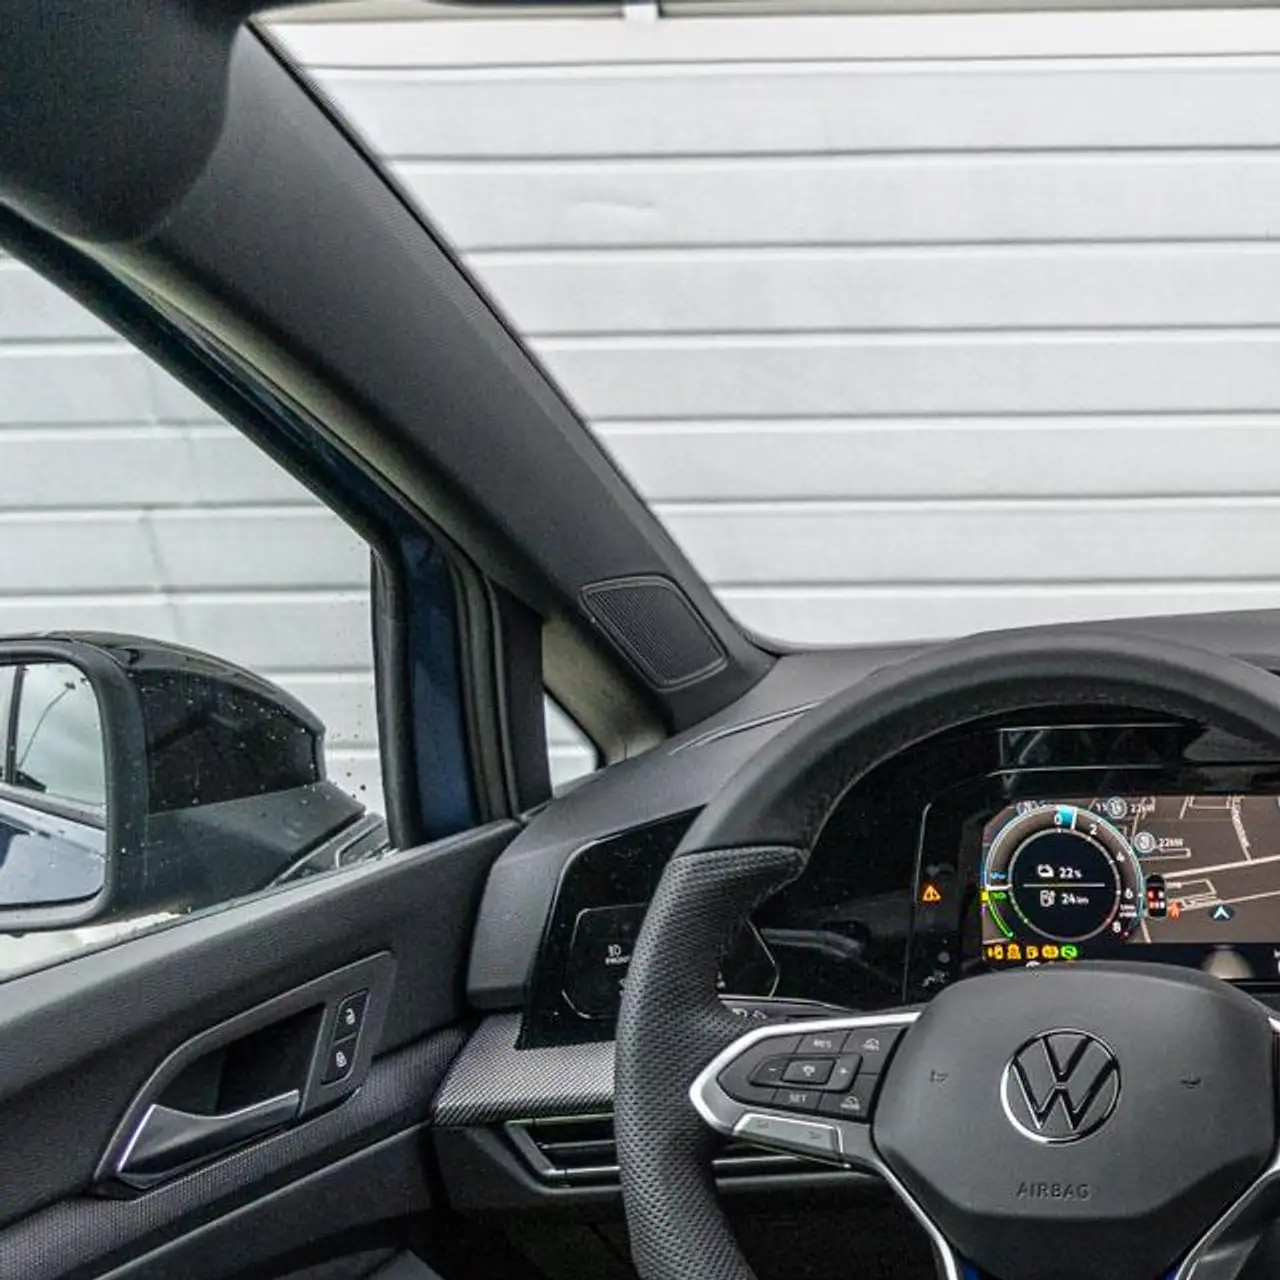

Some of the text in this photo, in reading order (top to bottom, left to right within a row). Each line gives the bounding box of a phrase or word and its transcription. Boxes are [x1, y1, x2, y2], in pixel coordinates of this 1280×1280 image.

[1089, 823, 1098, 836] 2
[1124, 888, 1133, 900] 6
[1111, 920, 1122, 933] 8
[1016, 1180, 1092, 1201] AIRBAG
